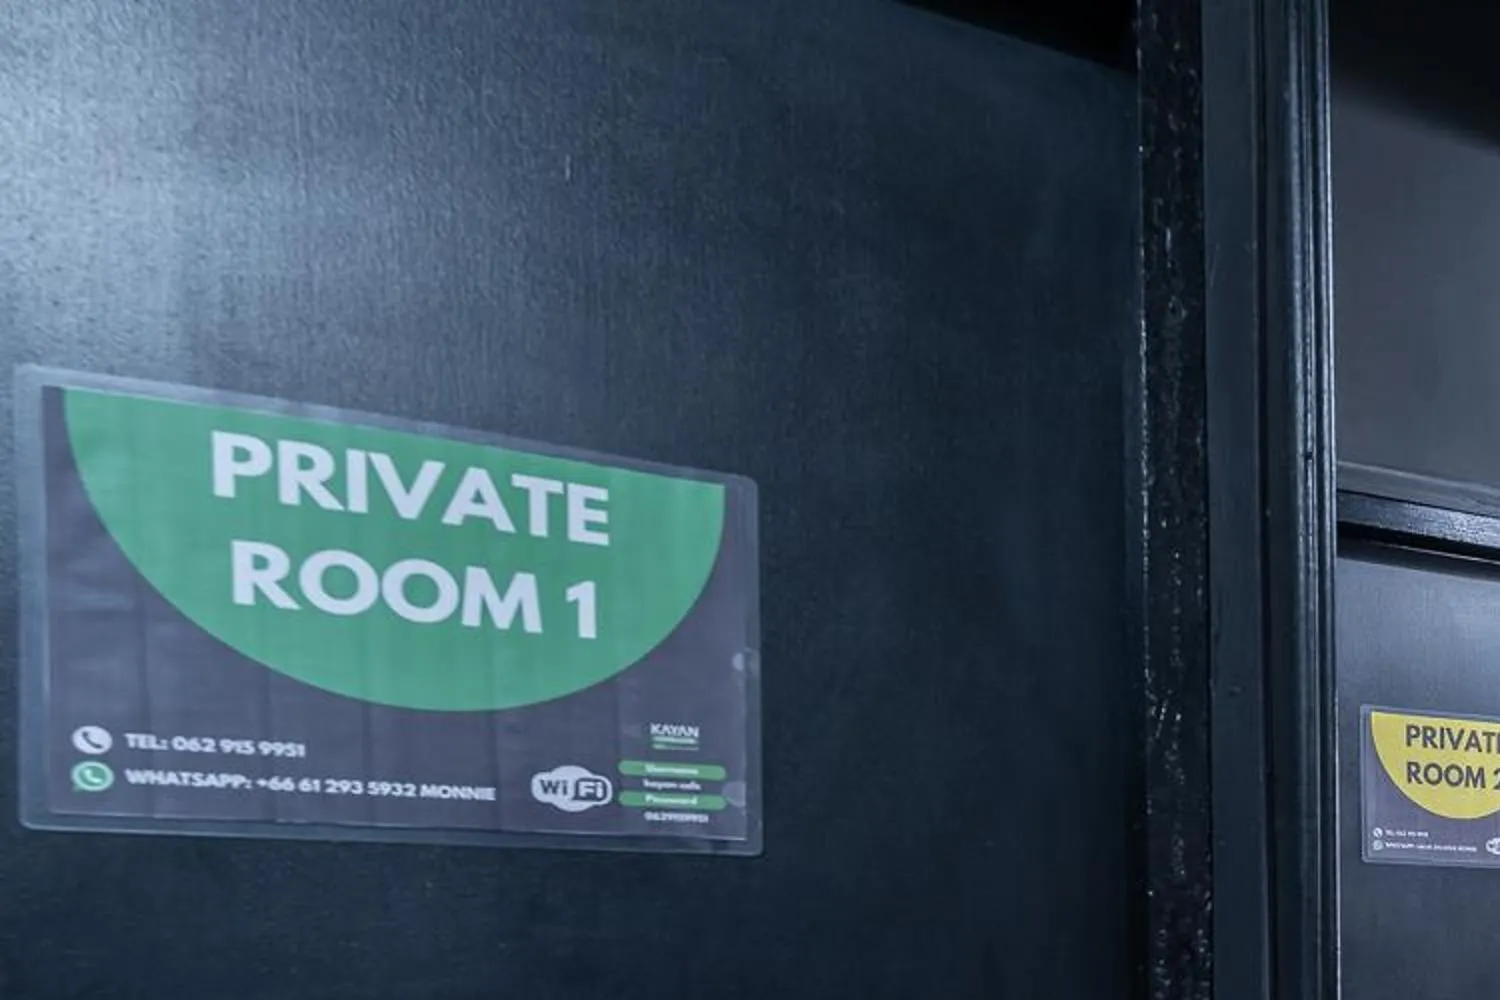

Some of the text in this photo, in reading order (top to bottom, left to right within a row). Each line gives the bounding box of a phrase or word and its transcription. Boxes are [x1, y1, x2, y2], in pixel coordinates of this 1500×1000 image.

[211, 430, 611, 547] PRIVATE
[231, 539, 598, 640] ROOM 1
[124, 732, 306, 758] TEL: 062 915 9951
[650, 722, 700, 738] KAYAN
[123, 767, 496, 801] WHATSAPP: +66 61 293 5932 MONNIE
[1407, 761, 1486, 790] ROOM
